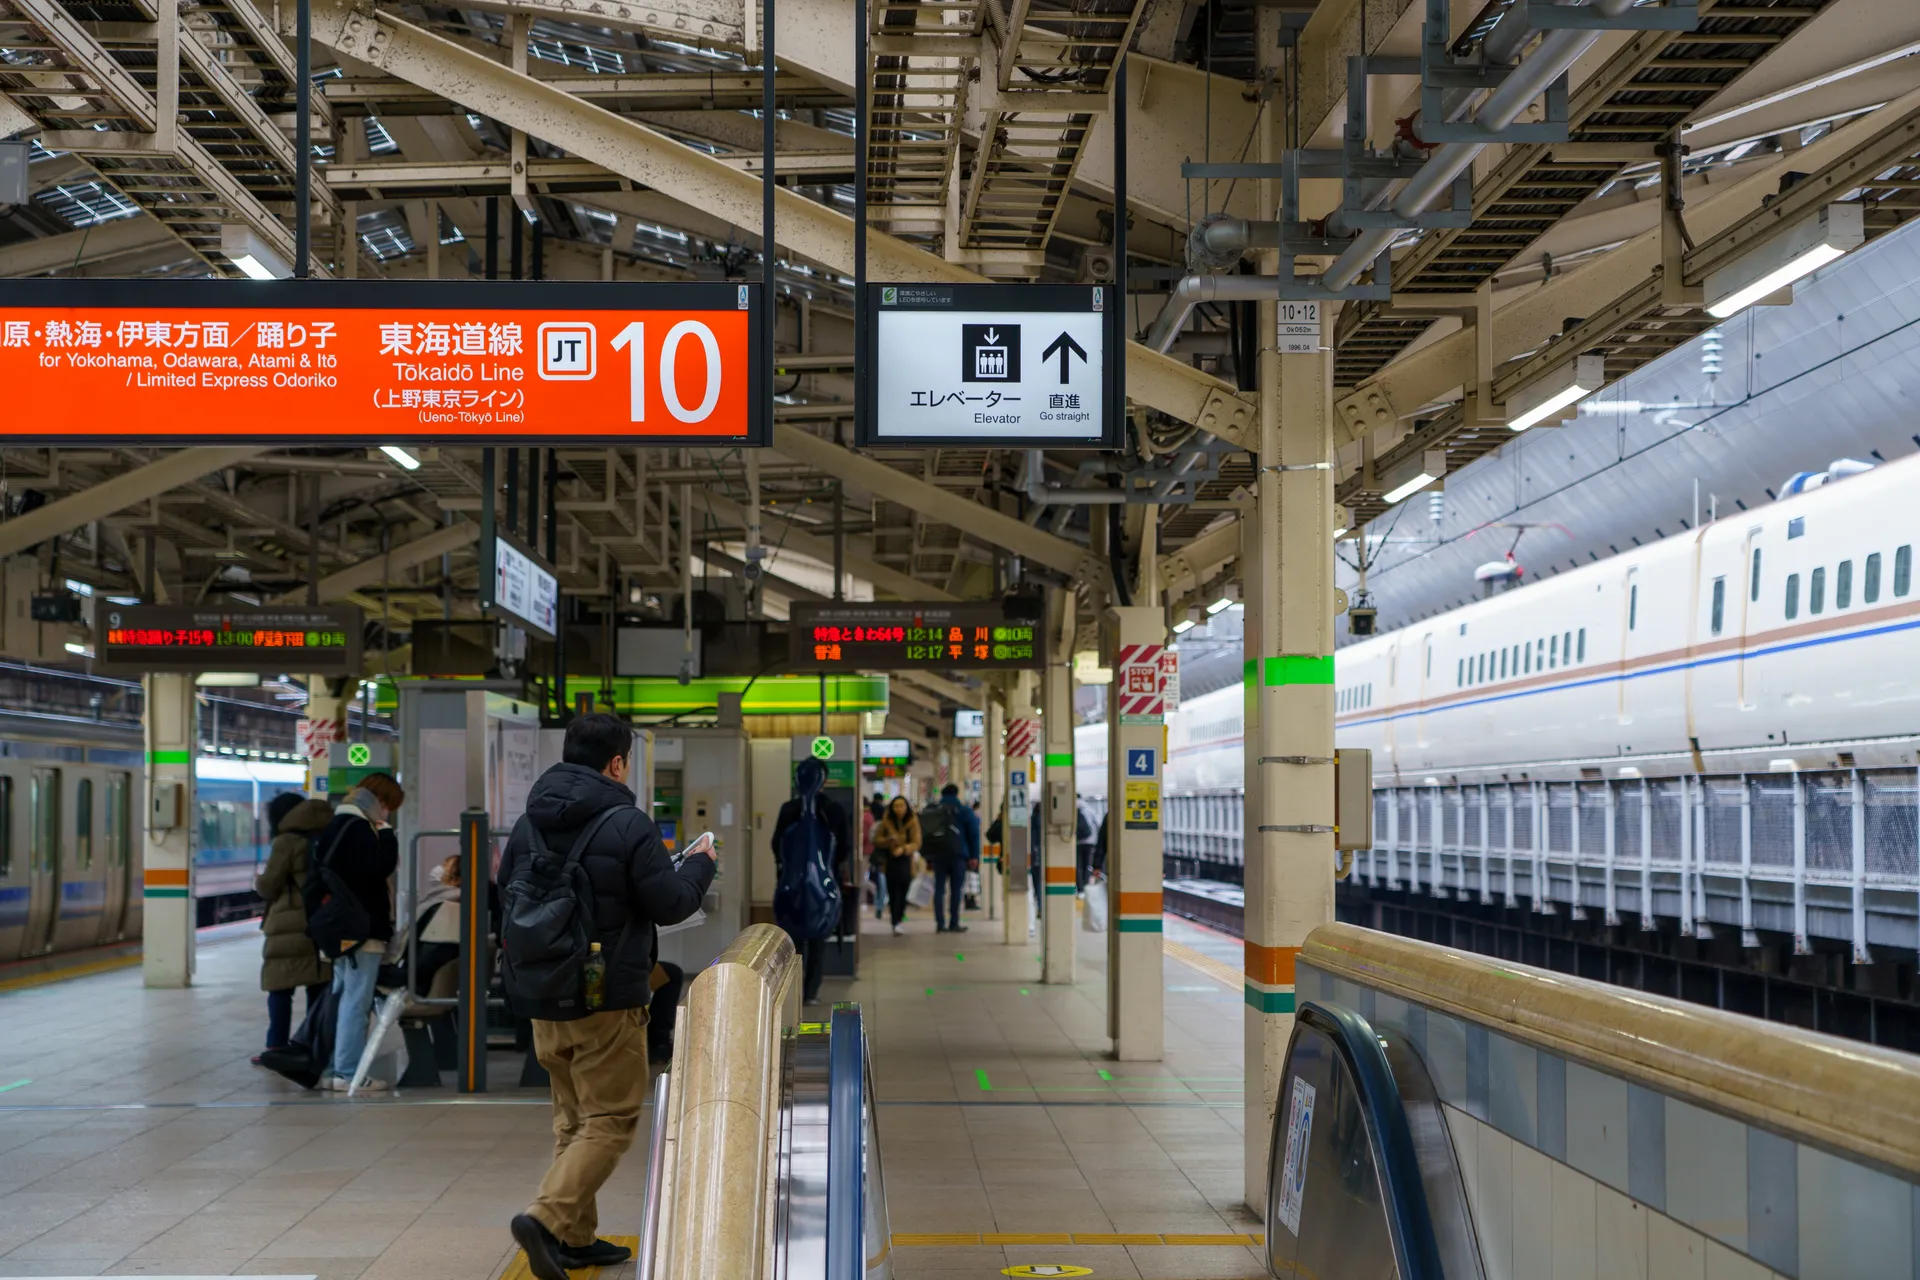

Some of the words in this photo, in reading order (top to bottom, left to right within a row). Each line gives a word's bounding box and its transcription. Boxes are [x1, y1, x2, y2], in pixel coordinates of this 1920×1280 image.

[0, 321, 337, 348] 原・熱海・伊東方面／踊り子
[379, 322, 523, 356] 東海道線
[552, 340, 581, 363] JT
[39, 353, 61, 367] for
[66, 353, 157, 369] Yokohama,
[163, 353, 242, 369] Odawara,
[248, 353, 295, 368] Atami
[299, 353, 311, 368] &
[317, 353, 337, 368] Itō
[393, 363, 473, 381] Tōkaidō
[481, 363, 524, 381] Line
[609, 320, 722, 424] 10
[137, 373, 196, 387] Limited
[202, 373, 268, 390] Express
[273, 373, 337, 387] Odoriko
[910, 390, 1021, 408] エレベーター
[1049, 394, 1081, 408] 直進
[418, 411, 492, 424] (Ueno-Tōkyō
[496, 411, 524, 423] Line)
[974, 413, 1021, 424] Elevator
[1040, 412, 1053, 421] Go
[1056, 411, 1090, 422] straight
[109, 612, 121, 629] 9
[216, 631, 253, 646] 13:00
[906, 627, 943, 641] 12:14
[814, 644, 841, 660] 普通
[906, 644, 943, 659] 12:17
[1135, 754, 1147, 771] 4
